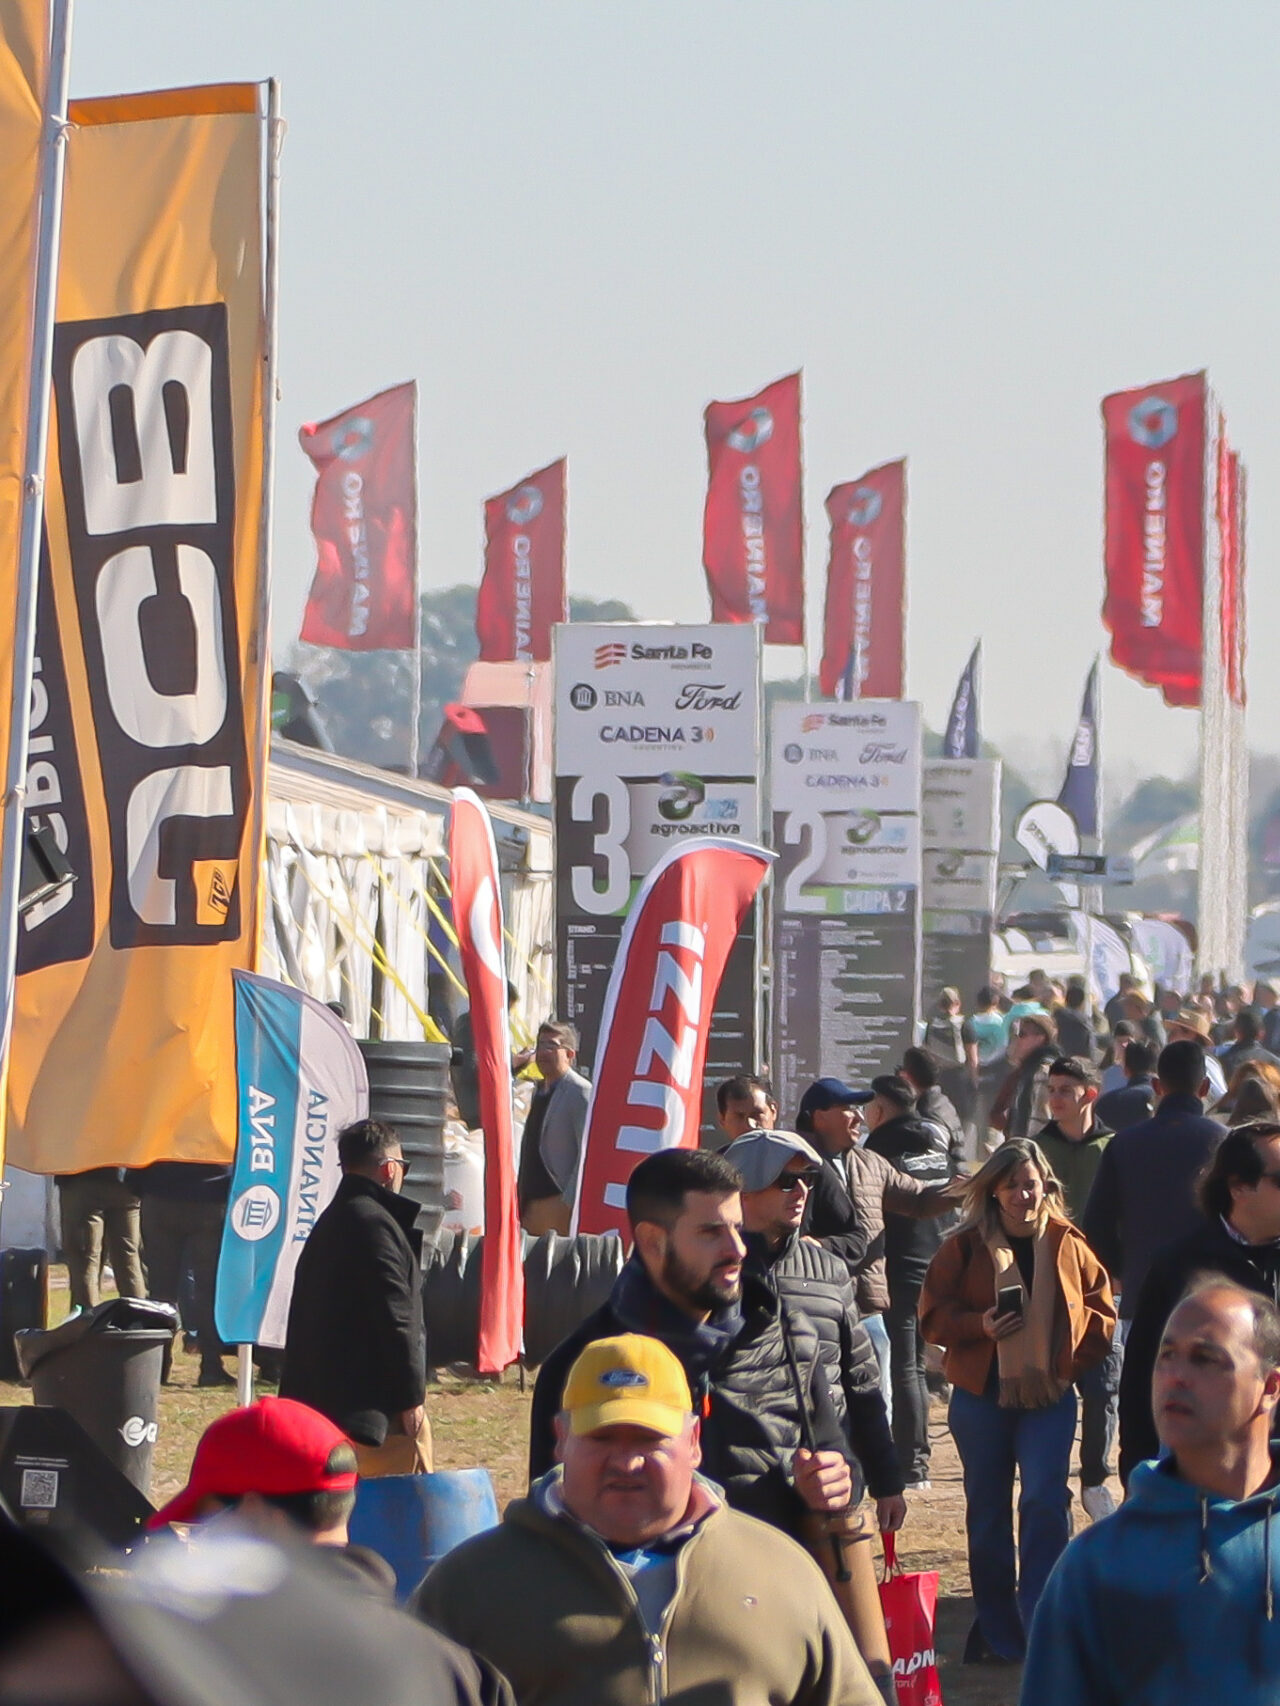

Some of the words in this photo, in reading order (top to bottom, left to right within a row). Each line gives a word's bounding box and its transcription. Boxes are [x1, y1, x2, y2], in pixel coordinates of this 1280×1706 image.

[631, 644, 688, 660] Santa
[692, 643, 712, 660] Fe
[604, 690, 645, 707] BNA
[675, 683, 742, 711] Ford
[828, 713, 869, 727] Santa
[872, 713, 887, 727] Fe
[600, 726, 686, 742] CADENA
[691, 726, 703, 742] 3
[859, 743, 908, 765] Ford
[806, 775, 868, 787] CADENA
[650, 822, 740, 837] agroactiva
[572, 773, 632, 915] 3
[785, 810, 827, 912] 2
